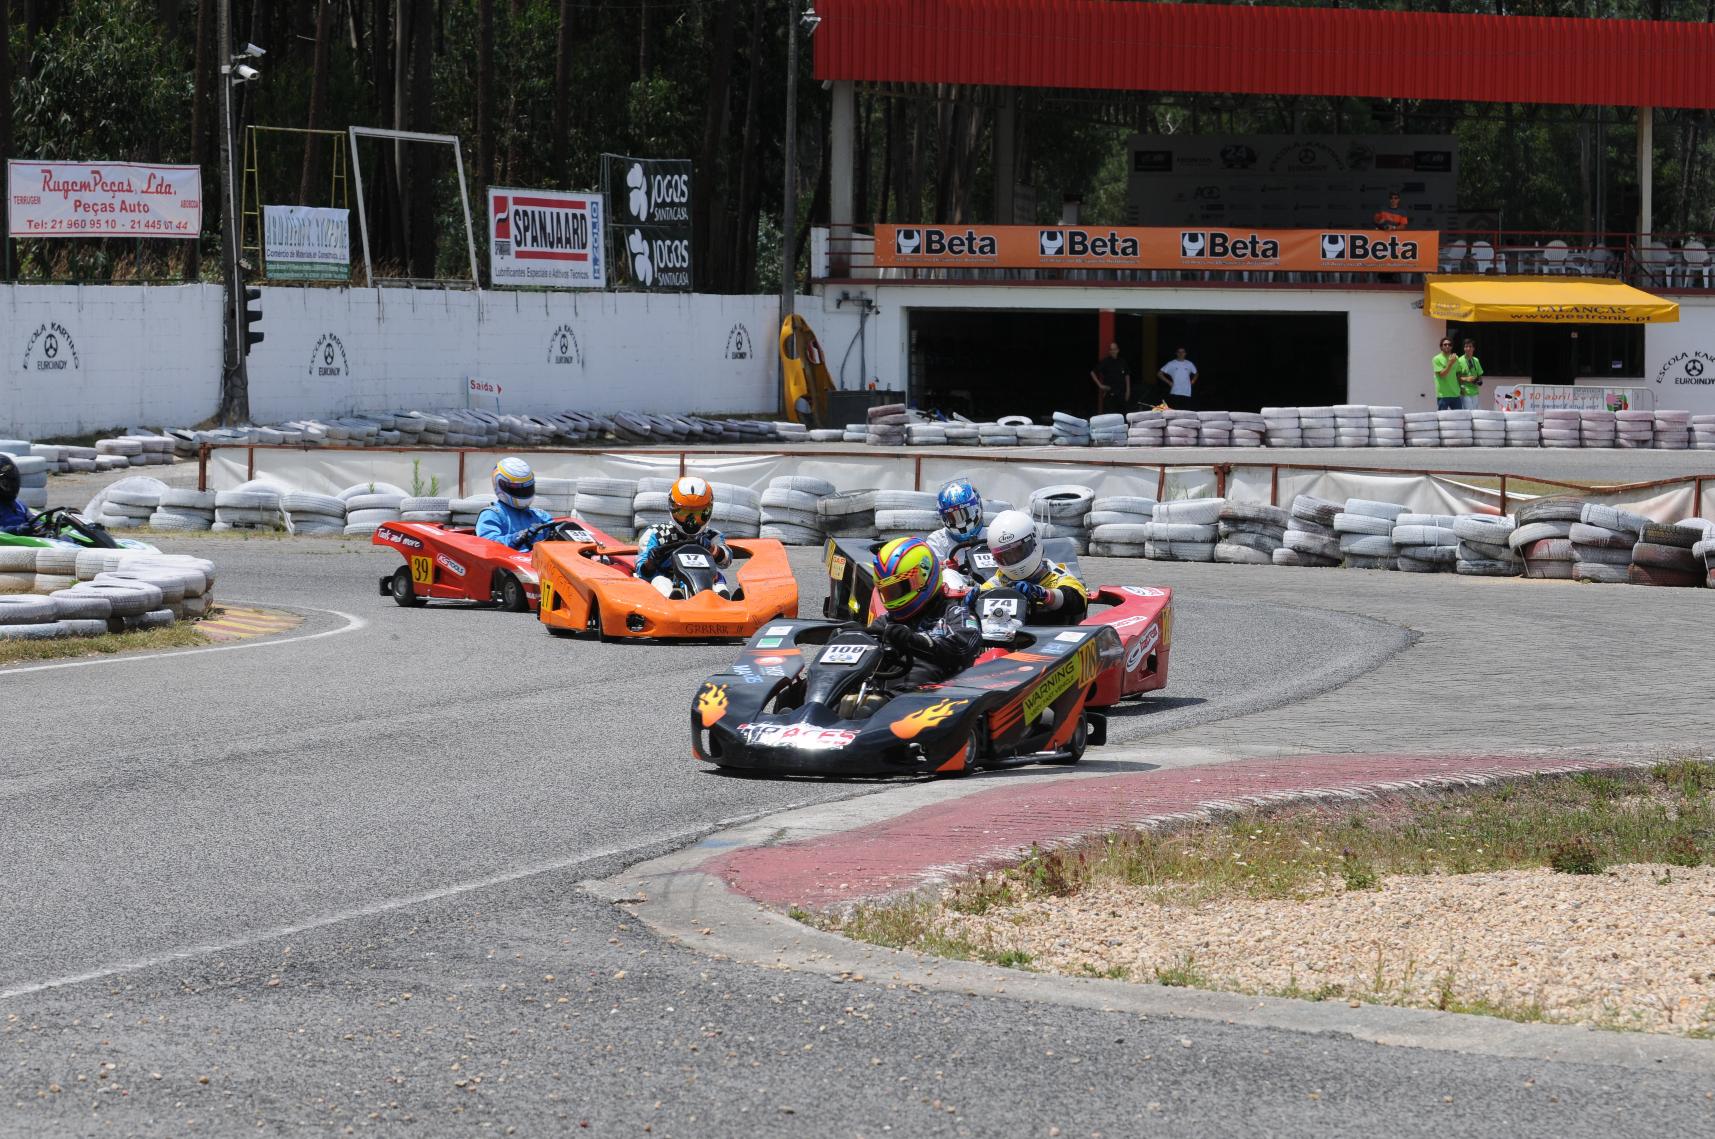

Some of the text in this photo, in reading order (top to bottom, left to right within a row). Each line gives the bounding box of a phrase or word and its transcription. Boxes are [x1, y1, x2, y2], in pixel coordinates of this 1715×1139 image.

[650, 174, 689, 213] JOGOS
[73, 200, 150, 216] Peças Auto
[26, 219, 48, 230] Tel:
[50, 220, 63, 230] 21
[66, 220, 87, 230] 960
[89, 220, 102, 229] 95
[105, 219, 117, 229] 10
[130, 219, 141, 230] 21
[144, 220, 162, 230] 445
[175, 221, 188, 231] 44
[513, 208, 588, 250] SPANJAARD
[924, 229, 998, 256] Beta
[1067, 230, 1140, 257] Beta
[1208, 232, 1280, 259] Beta
[1349, 234, 1418, 261] Beta
[653, 239, 689, 278] JOGOS
[1510, 312, 1651, 322] www.pestronix.pt
[1655, 352, 1688, 384] ESCOLA
[414, 558, 430, 581] 39
[988, 599, 1012, 608] 74
[1023, 660, 1075, 710] WARNING
